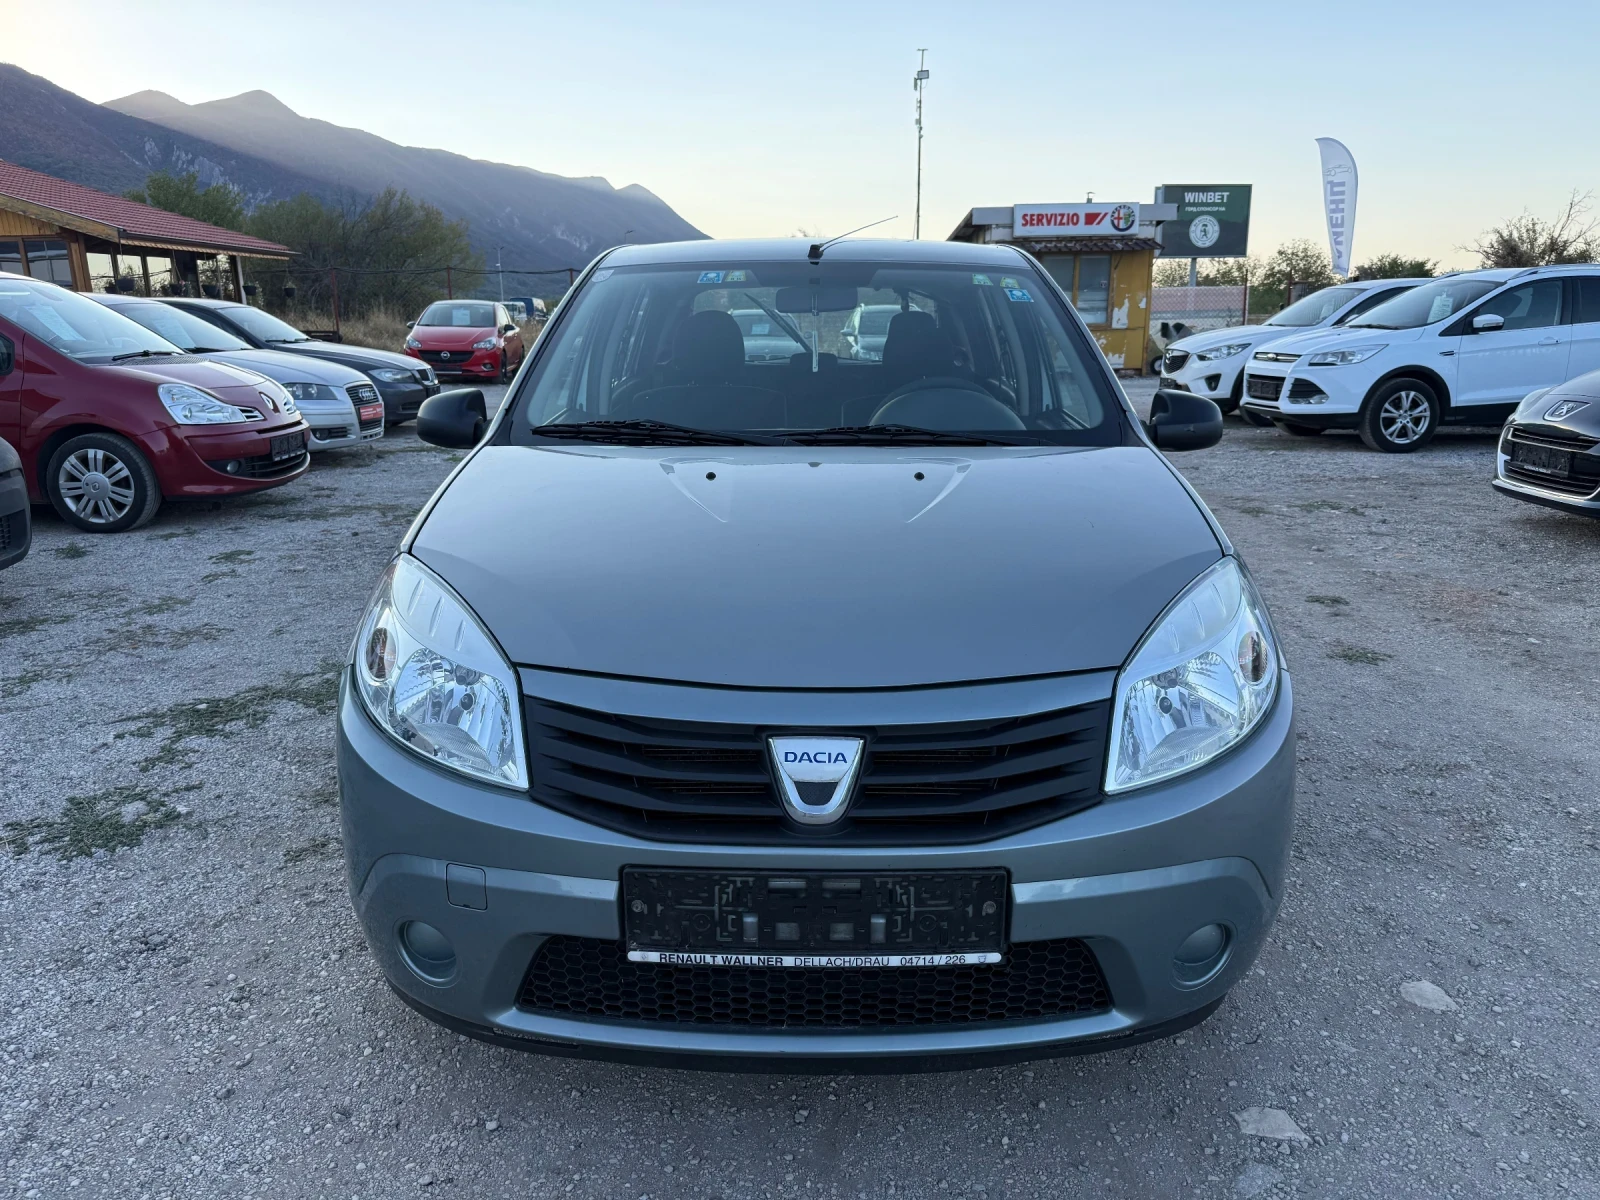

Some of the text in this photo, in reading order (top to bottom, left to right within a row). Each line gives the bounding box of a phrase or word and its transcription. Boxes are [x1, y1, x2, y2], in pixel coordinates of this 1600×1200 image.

[1184, 191, 1230, 203] WINBET
[1021, 212, 1080, 227] SERVIZIO
[784, 751, 848, 764] DACIA
[659, 953, 718, 965] RENAULT
[721, 955, 784, 967] WALLNER
[794, 956, 890, 967] DELLACH/DRAU
[900, 955, 935, 966] 04714
[944, 955, 966, 965] 226
